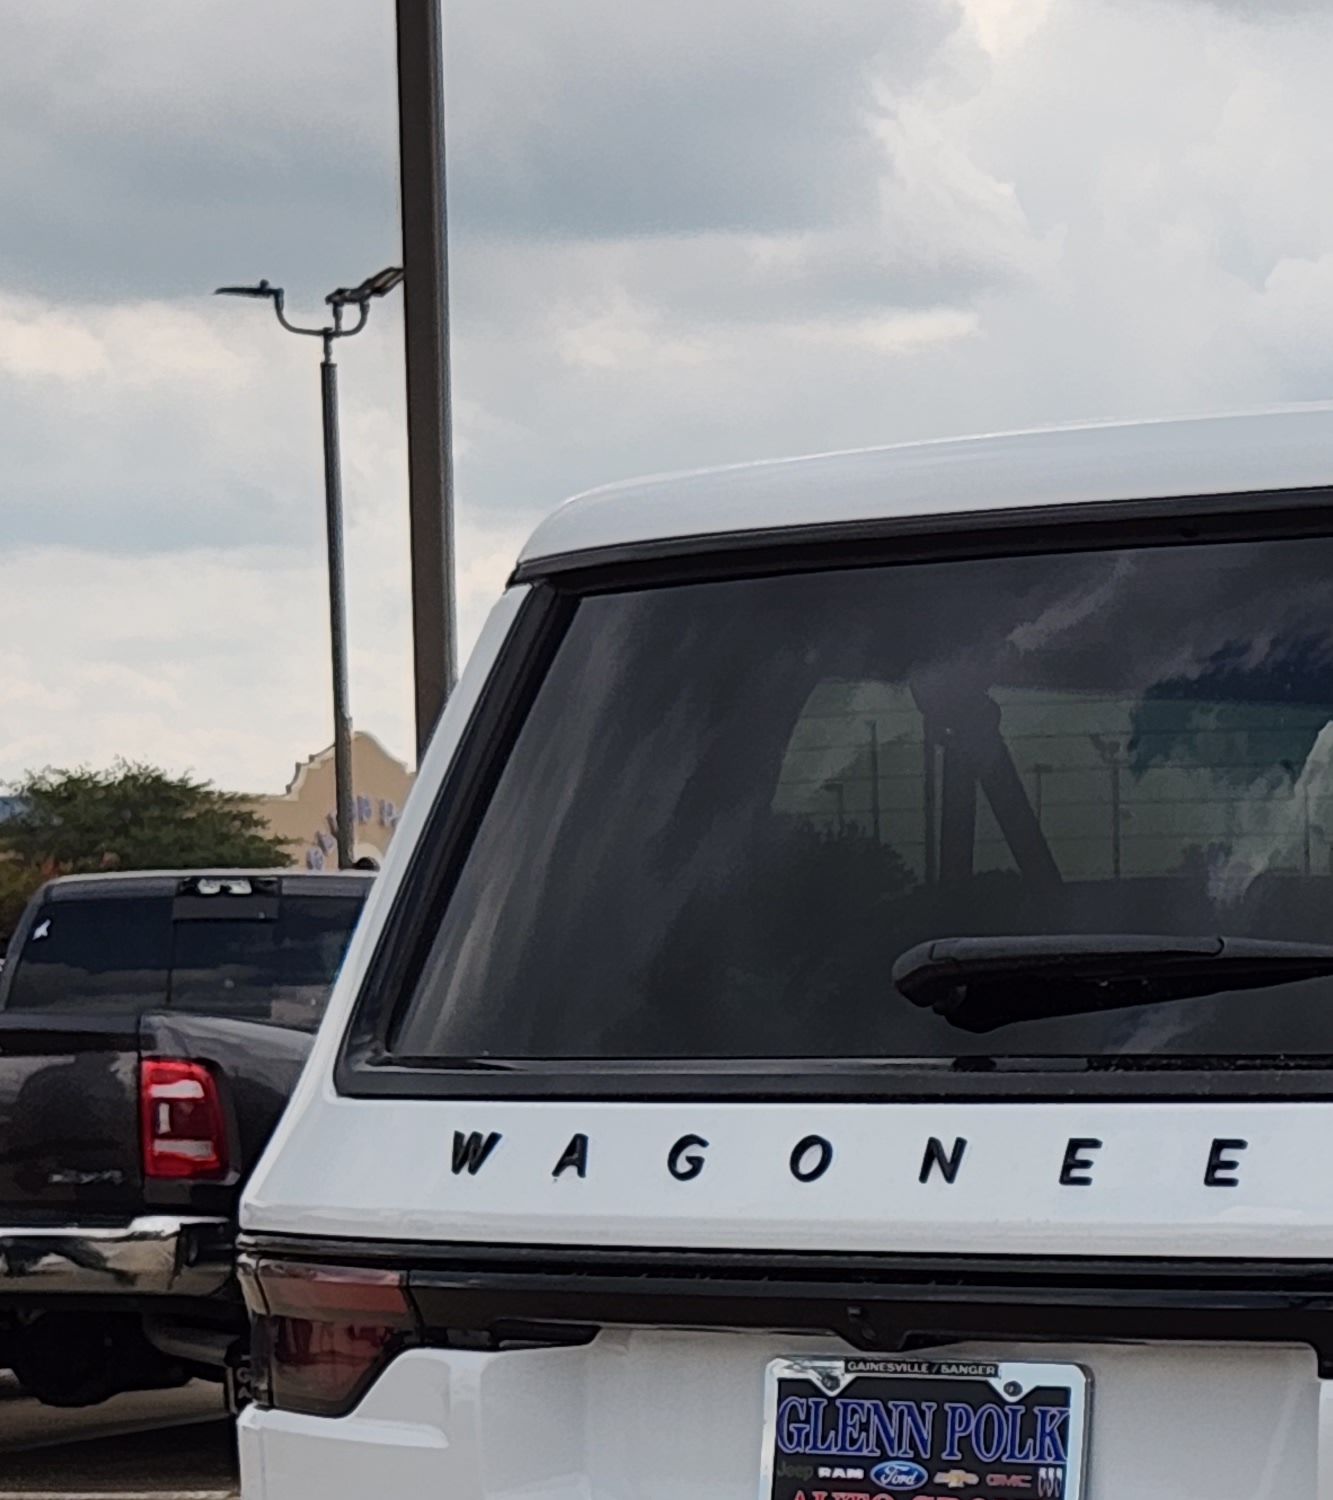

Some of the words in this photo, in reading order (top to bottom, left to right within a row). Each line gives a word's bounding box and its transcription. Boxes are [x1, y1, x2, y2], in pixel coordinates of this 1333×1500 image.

[847, 1361, 929, 1374] GAINESVILLE
[940, 1364, 996, 1375] SANGER
[777, 1396, 937, 1460] GLENN
[941, 1403, 1070, 1464] POLK
[818, 1466, 865, 1480] RAM
[879, 1463, 920, 1487] Ford
[985, 1473, 1033, 1488] GMC
